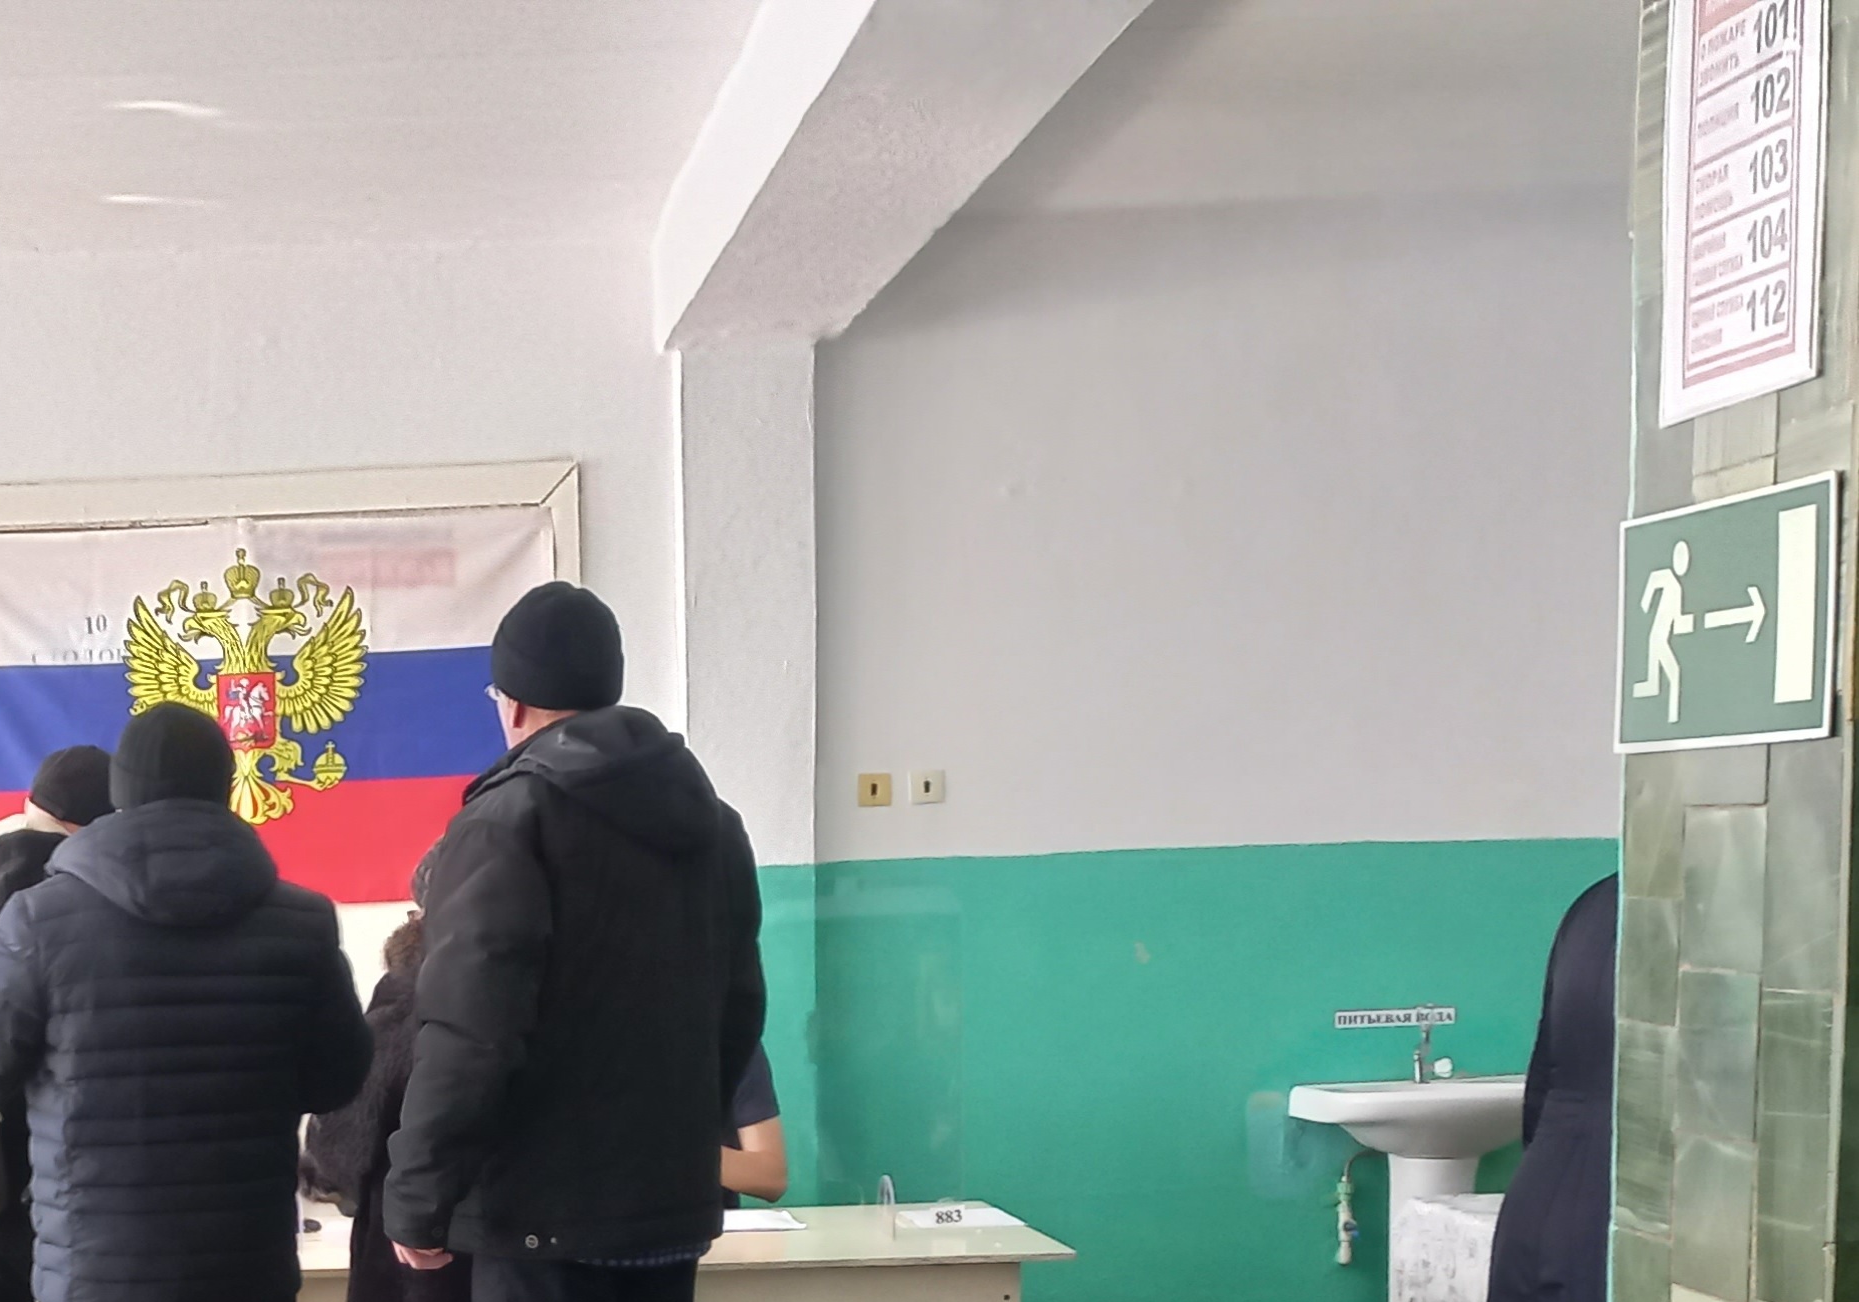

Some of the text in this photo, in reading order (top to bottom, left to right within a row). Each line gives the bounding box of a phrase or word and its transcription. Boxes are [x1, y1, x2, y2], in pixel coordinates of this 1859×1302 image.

[1750, 66, 1791, 125] 102
[1749, 138, 1789, 194] 103
[1747, 208, 1789, 263] 104
[1746, 279, 1787, 333] 112
[1337, 1012, 1412, 1026] ПИТЬЕВАЯ
[935, 1208, 963, 1225] 883
